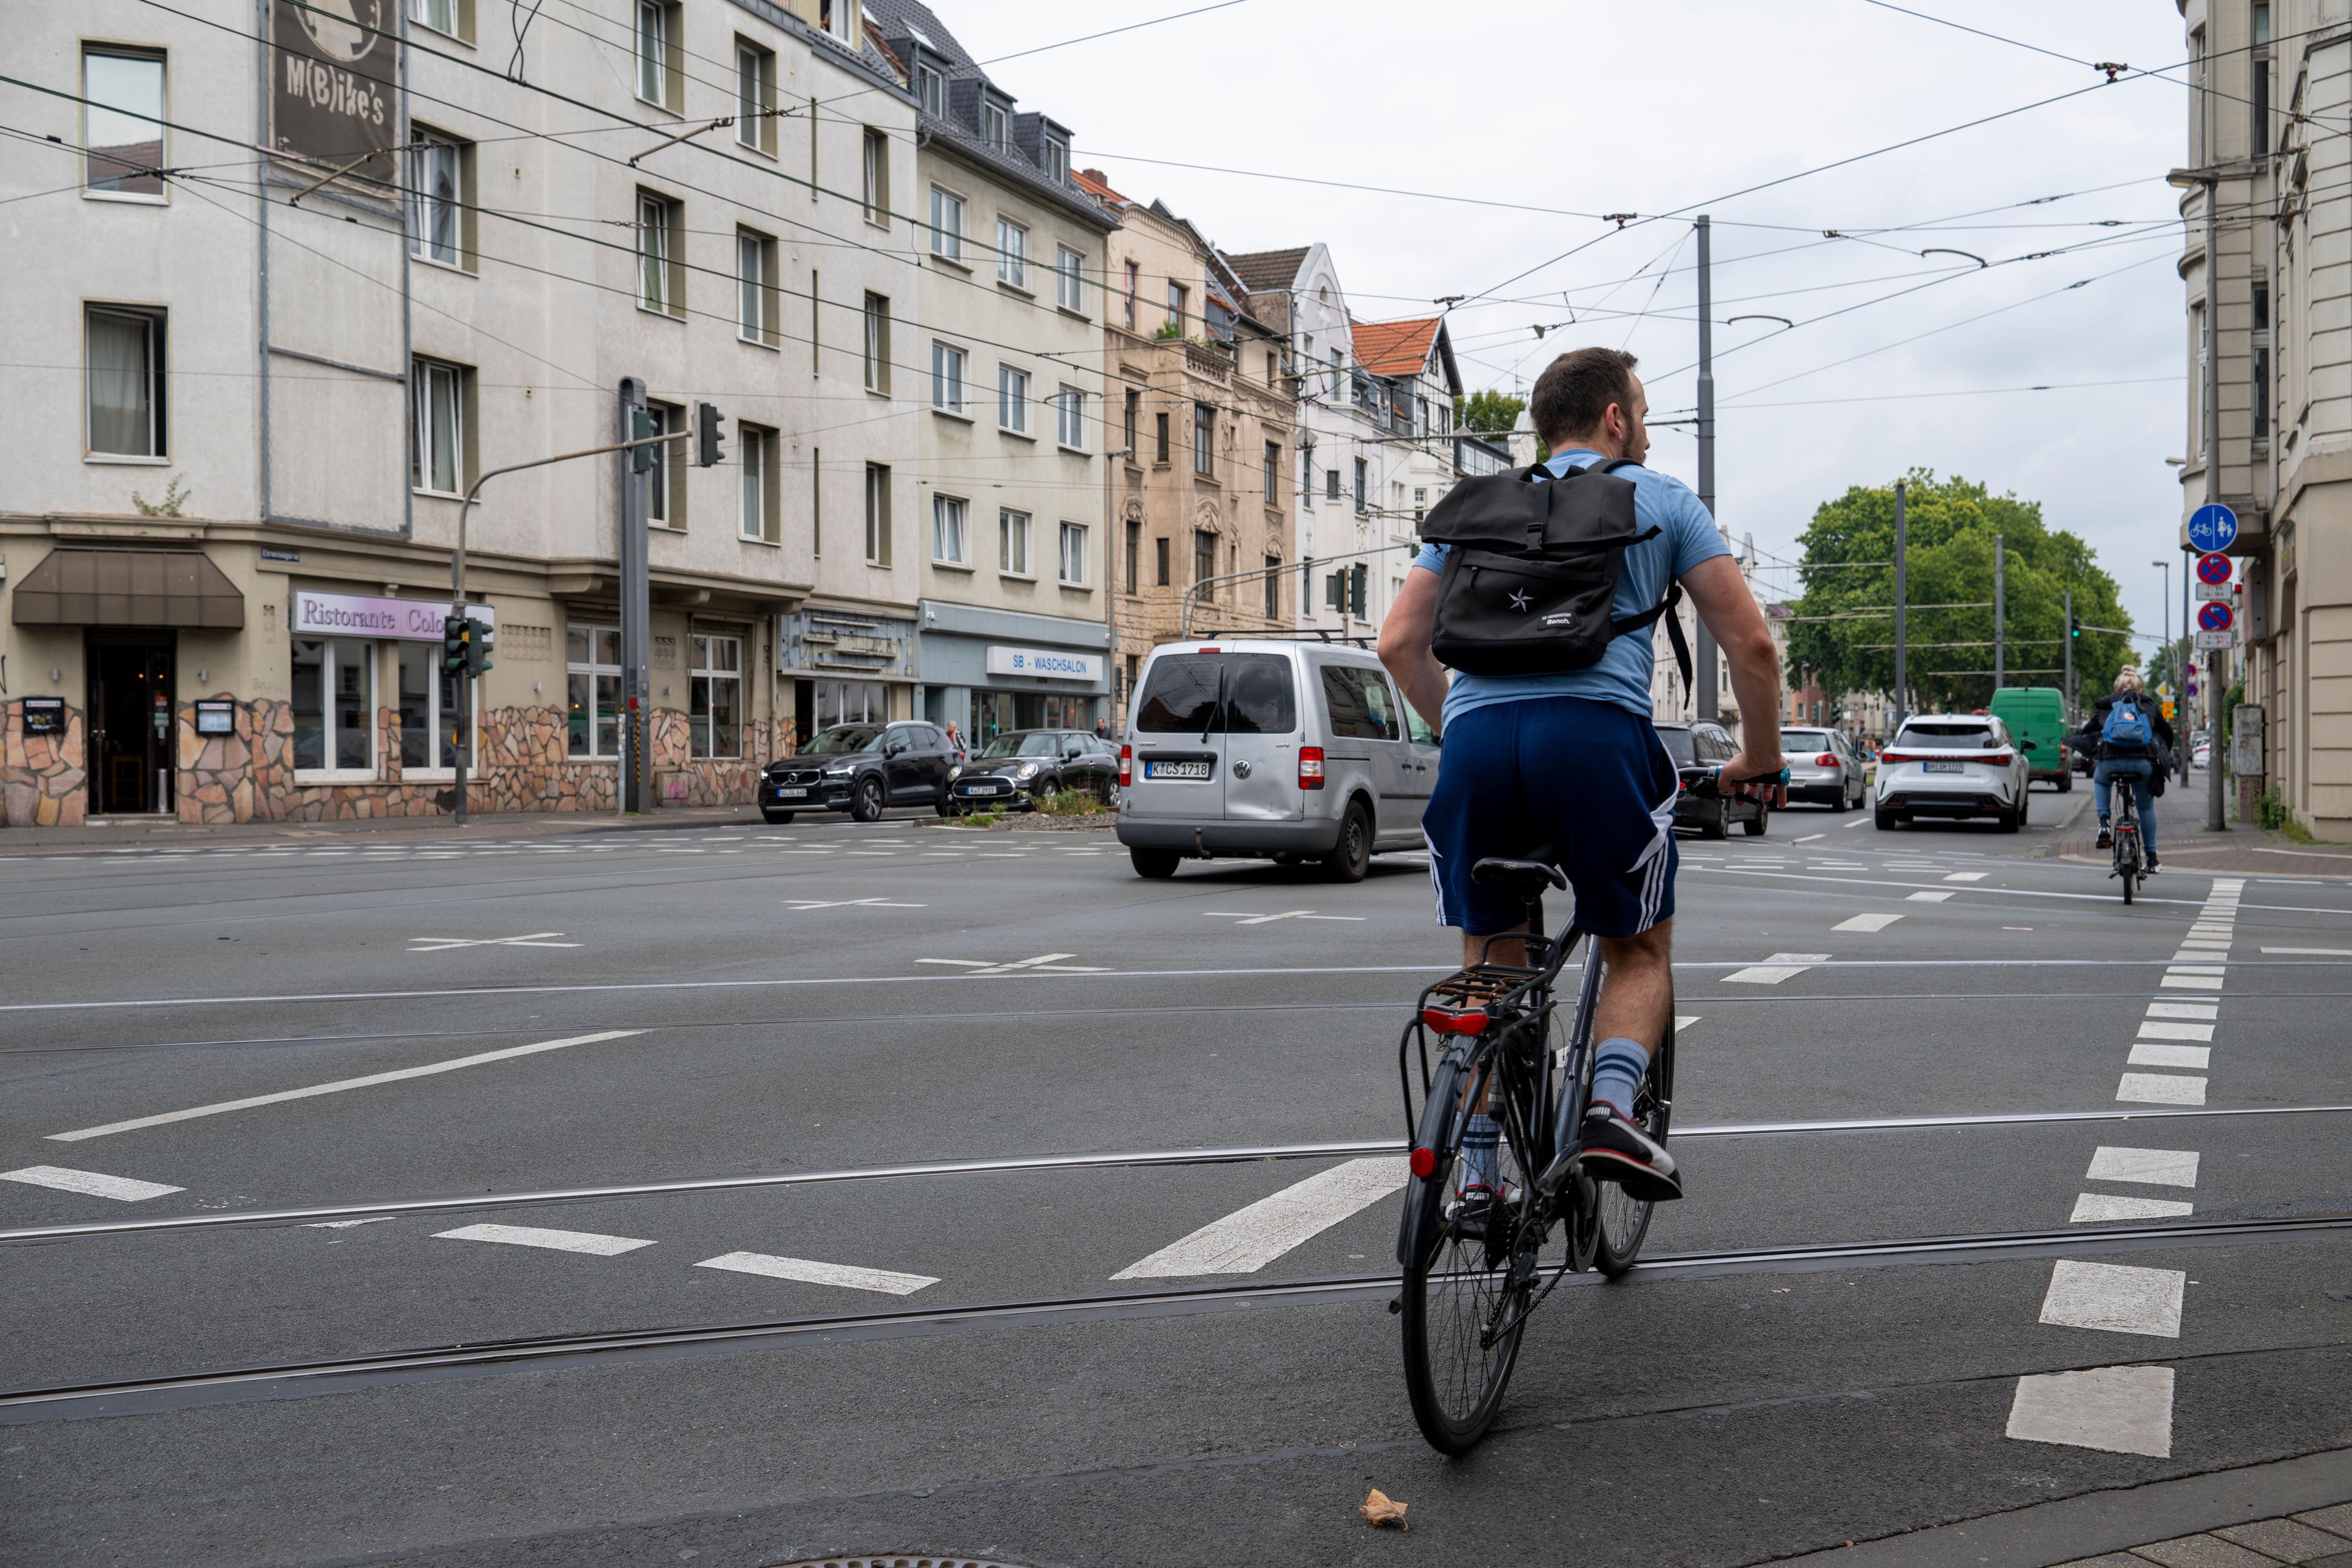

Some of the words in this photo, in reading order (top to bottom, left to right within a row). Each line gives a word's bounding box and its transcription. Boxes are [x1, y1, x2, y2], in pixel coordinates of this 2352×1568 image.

[286, 55, 384, 125] M(B)ike's
[303, 599, 395, 629] Ristorante
[1013, 655, 1024, 668] SB
[1035, 657, 1087, 673] WASCHSALON
[1586, 1106, 1611, 1118] PUMA
[1466, 1192, 1490, 1201] PUMA
